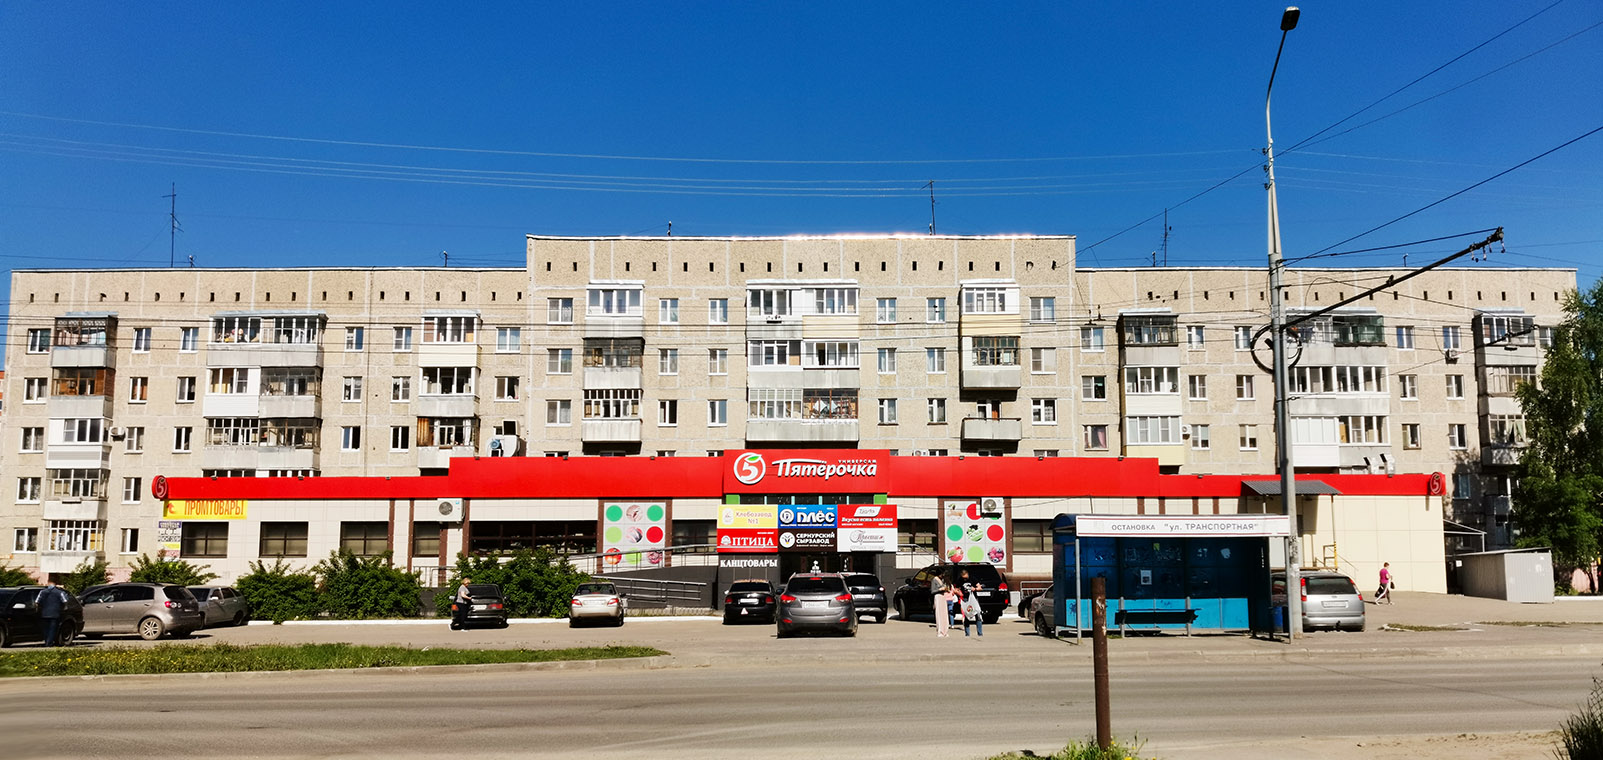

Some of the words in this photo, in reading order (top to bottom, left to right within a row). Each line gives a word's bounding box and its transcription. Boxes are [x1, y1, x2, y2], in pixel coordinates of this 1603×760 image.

[184, 500, 244, 515] ПРОМТОВАРЫ
[732, 537, 774, 547] ПТИЦА
[720, 559, 778, 568] КАНЦТОВАРЫ
